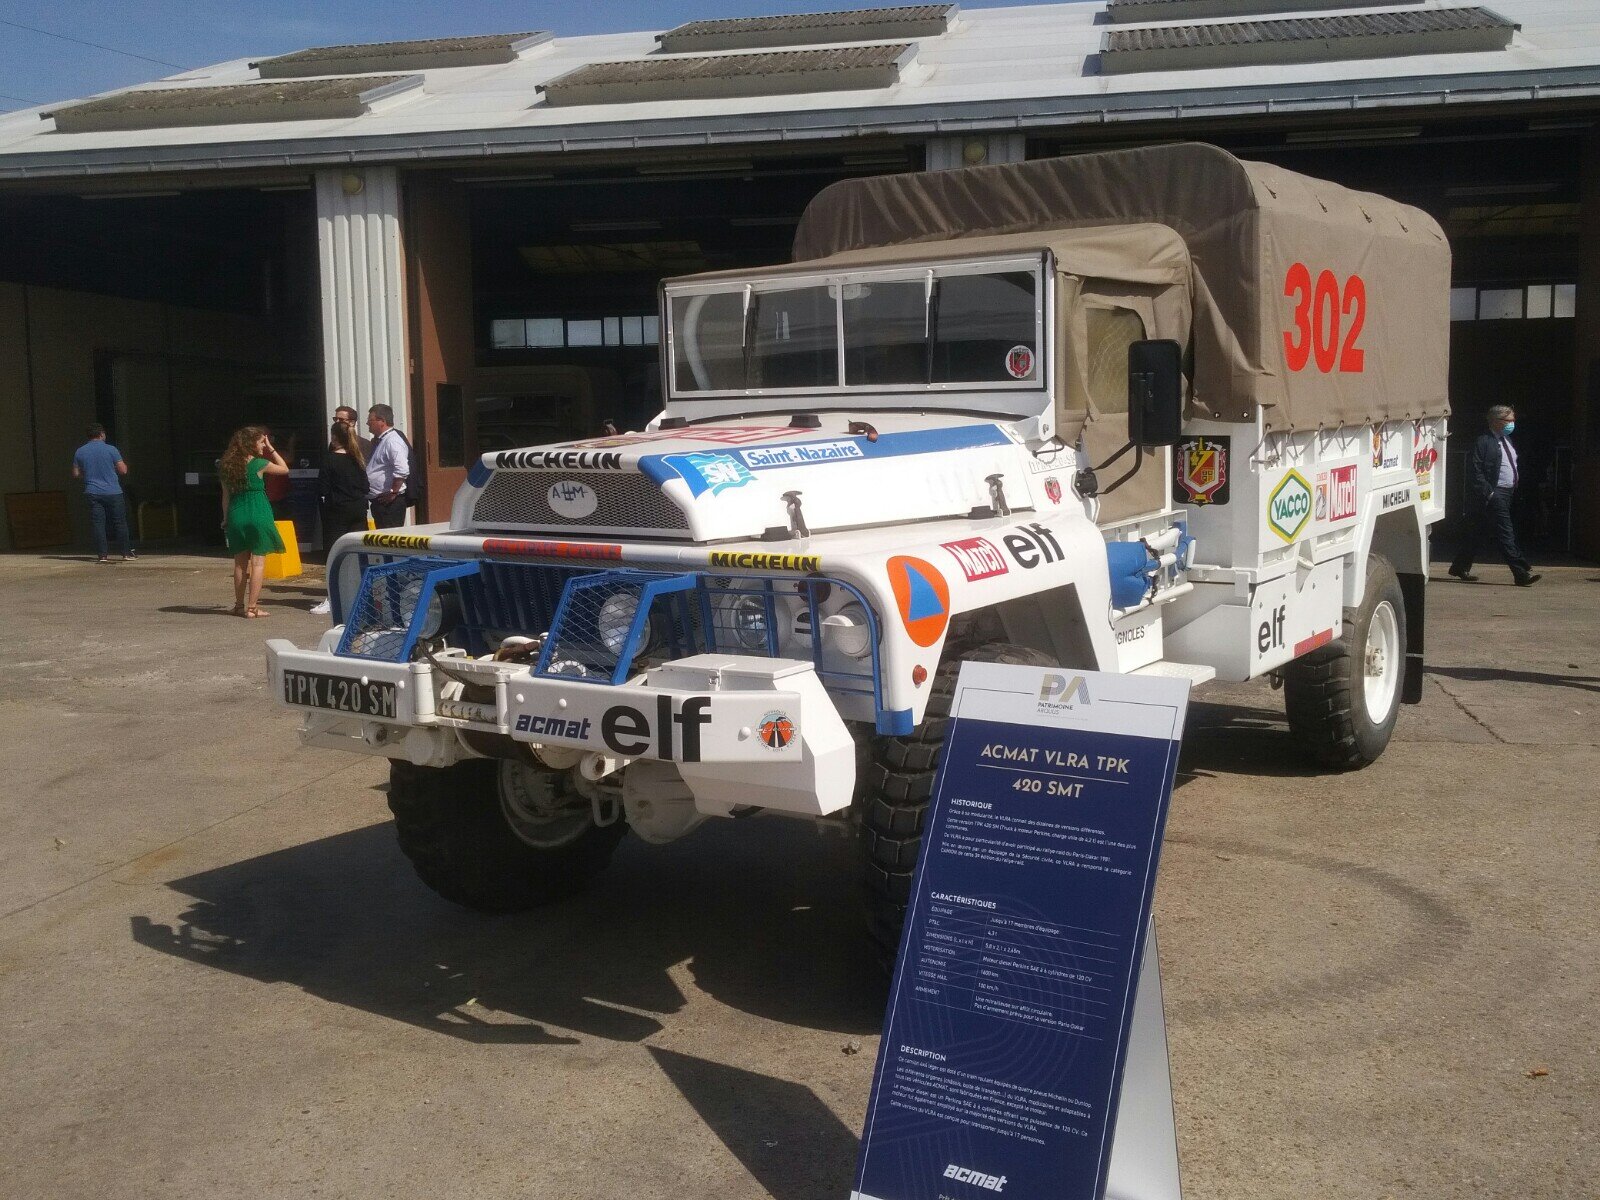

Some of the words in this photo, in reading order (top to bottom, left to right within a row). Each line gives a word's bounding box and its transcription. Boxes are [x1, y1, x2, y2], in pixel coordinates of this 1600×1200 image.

[1283, 263, 1366, 373] 302
[496, 452, 622, 470] MICHELIN
[1274, 492, 1309, 521] YACCO
[1382, 489, 1411, 510] MICHELIN
[363, 534, 430, 550] MICHELIN
[1002, 522, 1066, 570] elf
[711, 552, 818, 572] MICHELIN
[1258, 604, 1286, 654] elf
[285, 673, 320, 707] TPK
[326, 679, 361, 713] 420
[368, 684, 396, 717] SM
[1037, 701, 1074, 711] PATRIMOINE
[515, 714, 592, 741] acmat
[601, 694, 712, 763] elf
[981, 744, 1039, 763] ACMAT
[1044, 750, 1090, 769] VLRA
[1097, 756, 1131, 774] TPK
[1012, 778, 1042, 793] 420
[1047, 781, 1084, 798] SMT
[951, 798, 993, 810] HISTORIQUE
[931, 891, 997, 909] CARACTÉRISTIQUES
[900, 1044, 947, 1061] DESCRIPTION
[943, 1163, 1008, 1193] acmat
